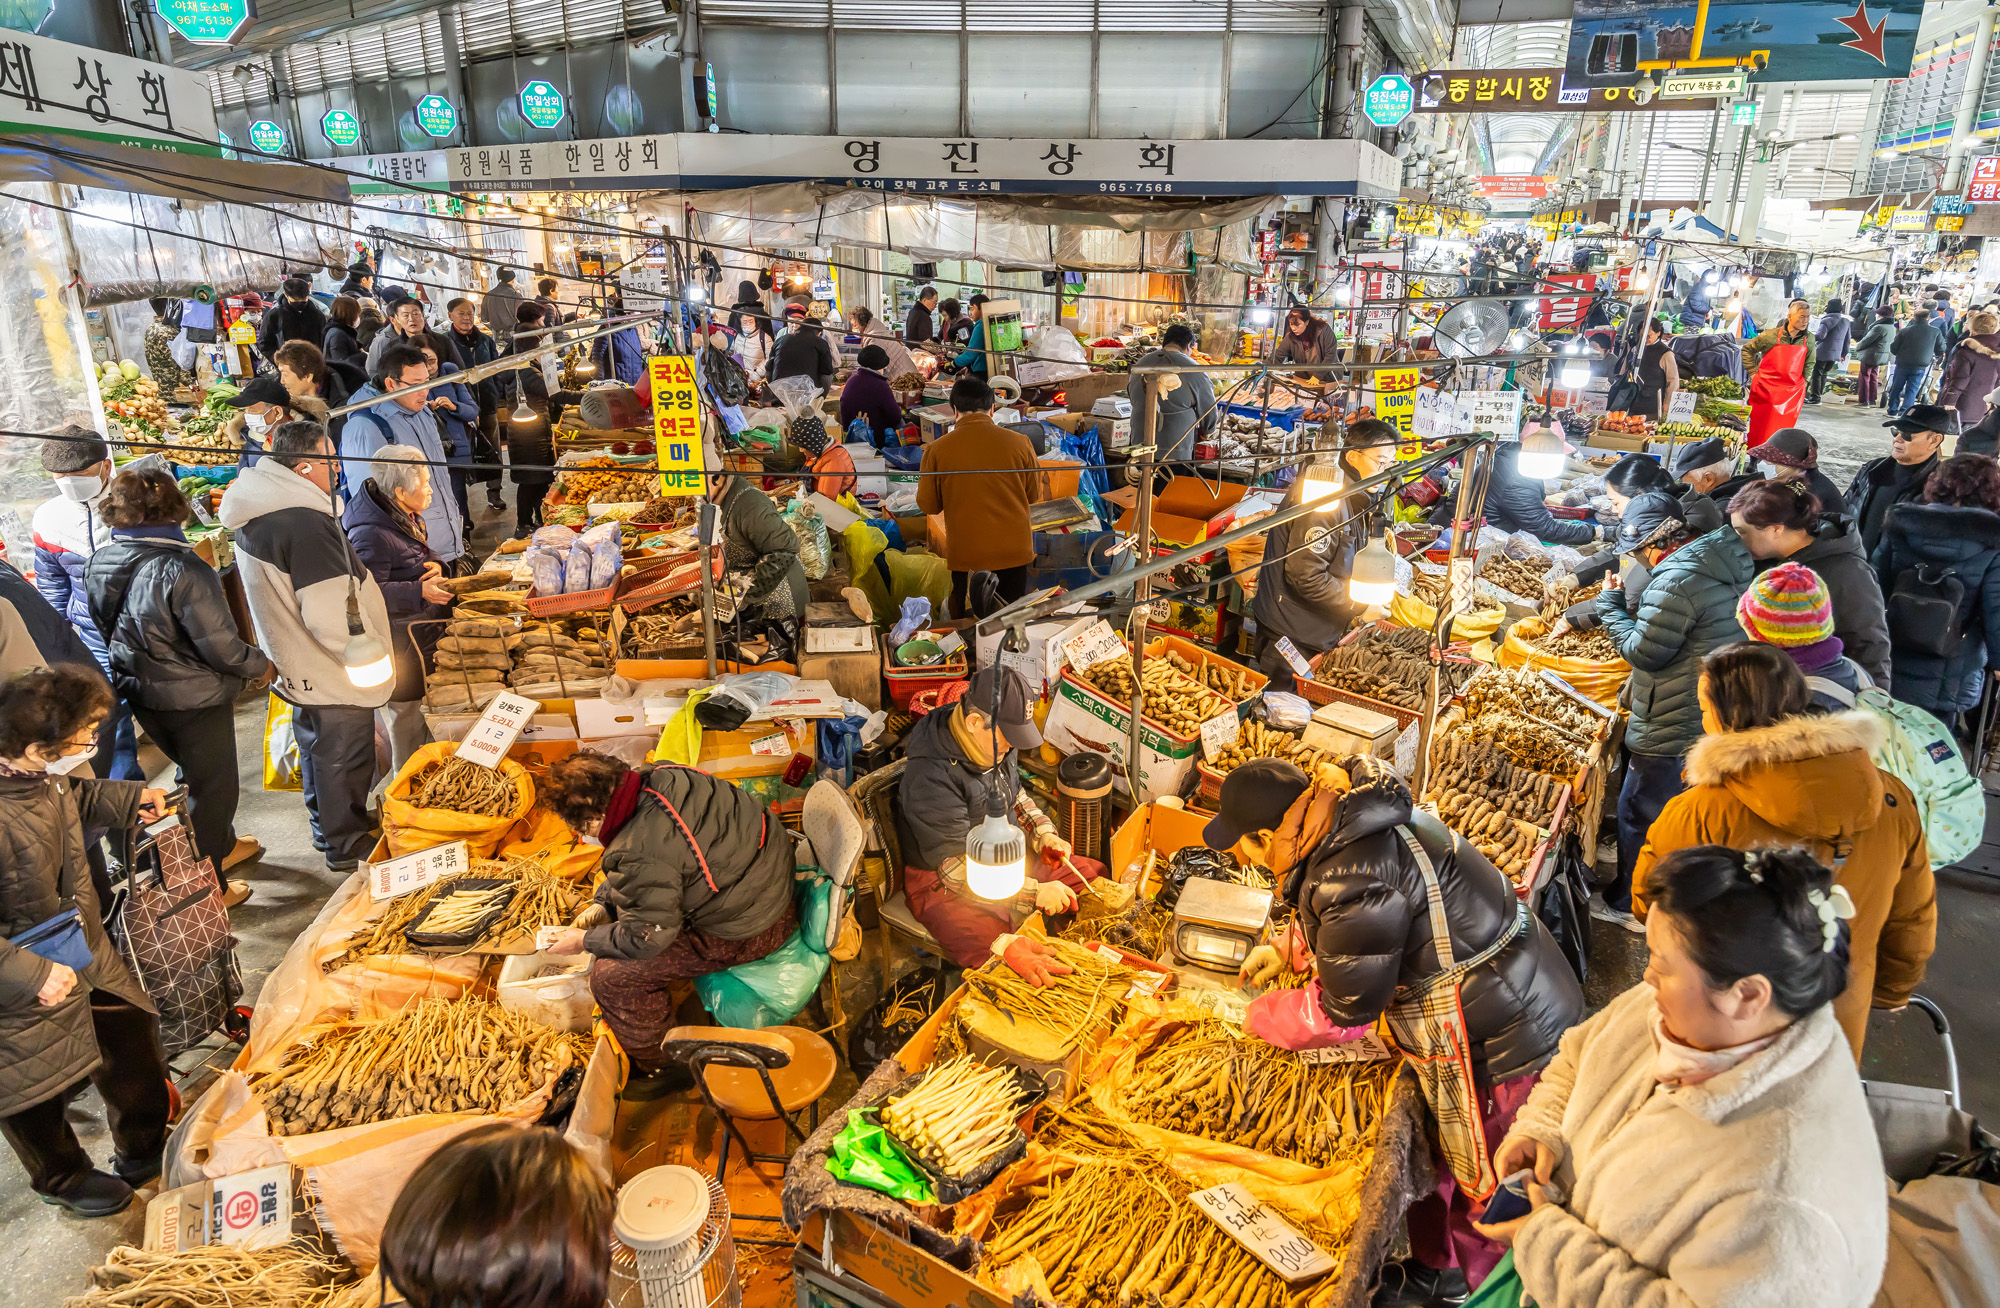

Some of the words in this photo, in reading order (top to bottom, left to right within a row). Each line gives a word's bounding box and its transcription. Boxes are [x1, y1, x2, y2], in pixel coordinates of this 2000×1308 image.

[176, 15, 233, 26] 967-6138
[1448, 76, 1552, 103] 종합시장
[1668, 83, 1696, 92] CCTV
[1697, 81, 1723, 91] 작동중
[524, 94, 560, 107] 한일상회
[1369, 90, 1410, 104] 영진식품
[421, 107, 453, 118] 정원식품
[326, 120, 356, 130] 나물담다
[459, 148, 533, 178] 정원식품
[564, 138, 659, 173] 한일상회
[843, 138, 1177, 176] 영진상회
[377, 156, 427, 181] 나물담다
[862, 180, 885, 190] 오이
[894, 180, 917, 190] 호박
[925, 180, 949, 190] 고추
[957, 181, 1001, 191] 도·소매
[654, 363, 691, 384] 국산
[1380, 374, 1415, 392] 국산
[657, 389, 693, 411] 우엉
[1383, 394, 1413, 407] 100%
[660, 417, 696, 438] 연근
[669, 443, 691, 462] 마
[1088, 625, 1104, 638] 더덕
[498, 700, 524, 715] 강원도
[1070, 691, 1107, 719] 소백산
[491, 713, 515, 728] 도라지
[485, 727, 491, 735] 1
[493, 730, 504, 740] 근
[432, 854, 443, 869] 영주
[444, 846, 457, 869] 경상도
[415, 858, 426, 882] 도라지
[398, 873, 409, 883] 근
